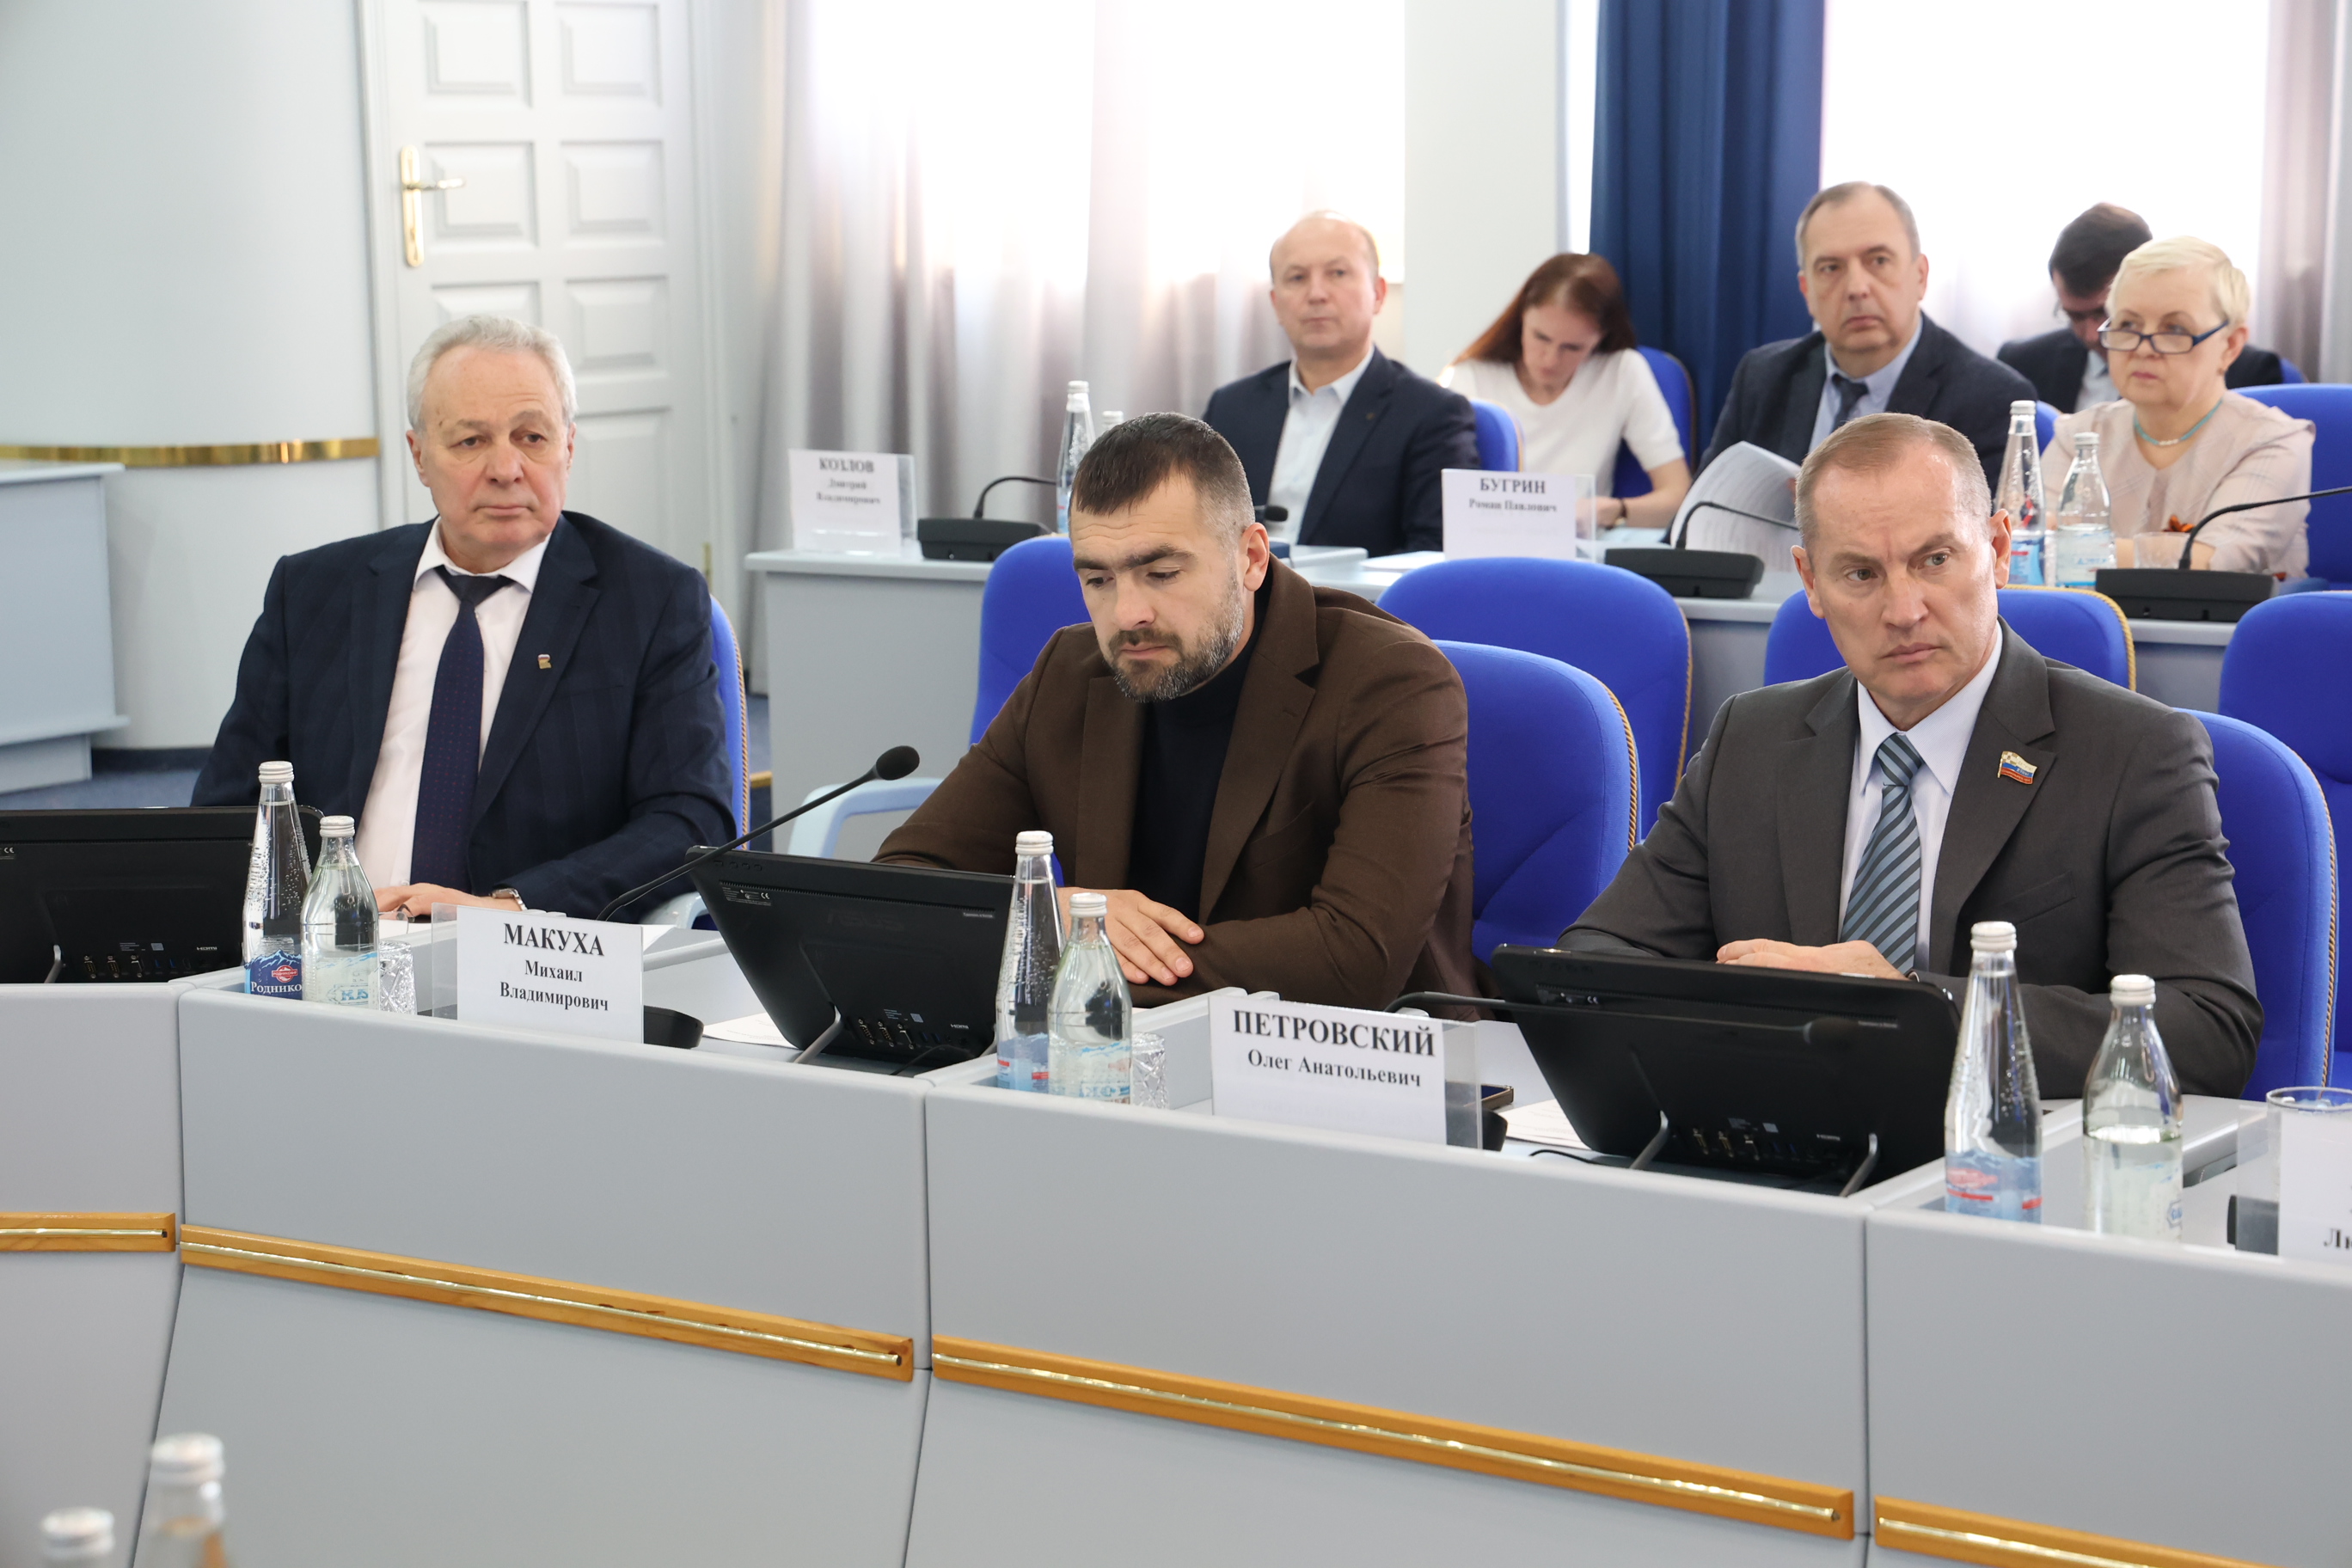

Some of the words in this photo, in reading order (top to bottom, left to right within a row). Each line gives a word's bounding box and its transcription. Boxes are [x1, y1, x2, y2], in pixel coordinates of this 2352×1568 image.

[1480, 478, 1546, 494] БУГРИН
[1469, 498, 1502, 511] Роман
[1504, 499, 1558, 512] Павлович
[504, 922, 605, 957] МАКУХА
[525, 959, 583, 983] Михаил
[499, 982, 609, 1011] Владимирович
[1232, 1009, 1436, 1057] ПЕТРОВСКИЙ
[1247, 1049, 1293, 1070] Олег
[1298, 1057, 1421, 1087] Анатольевич
